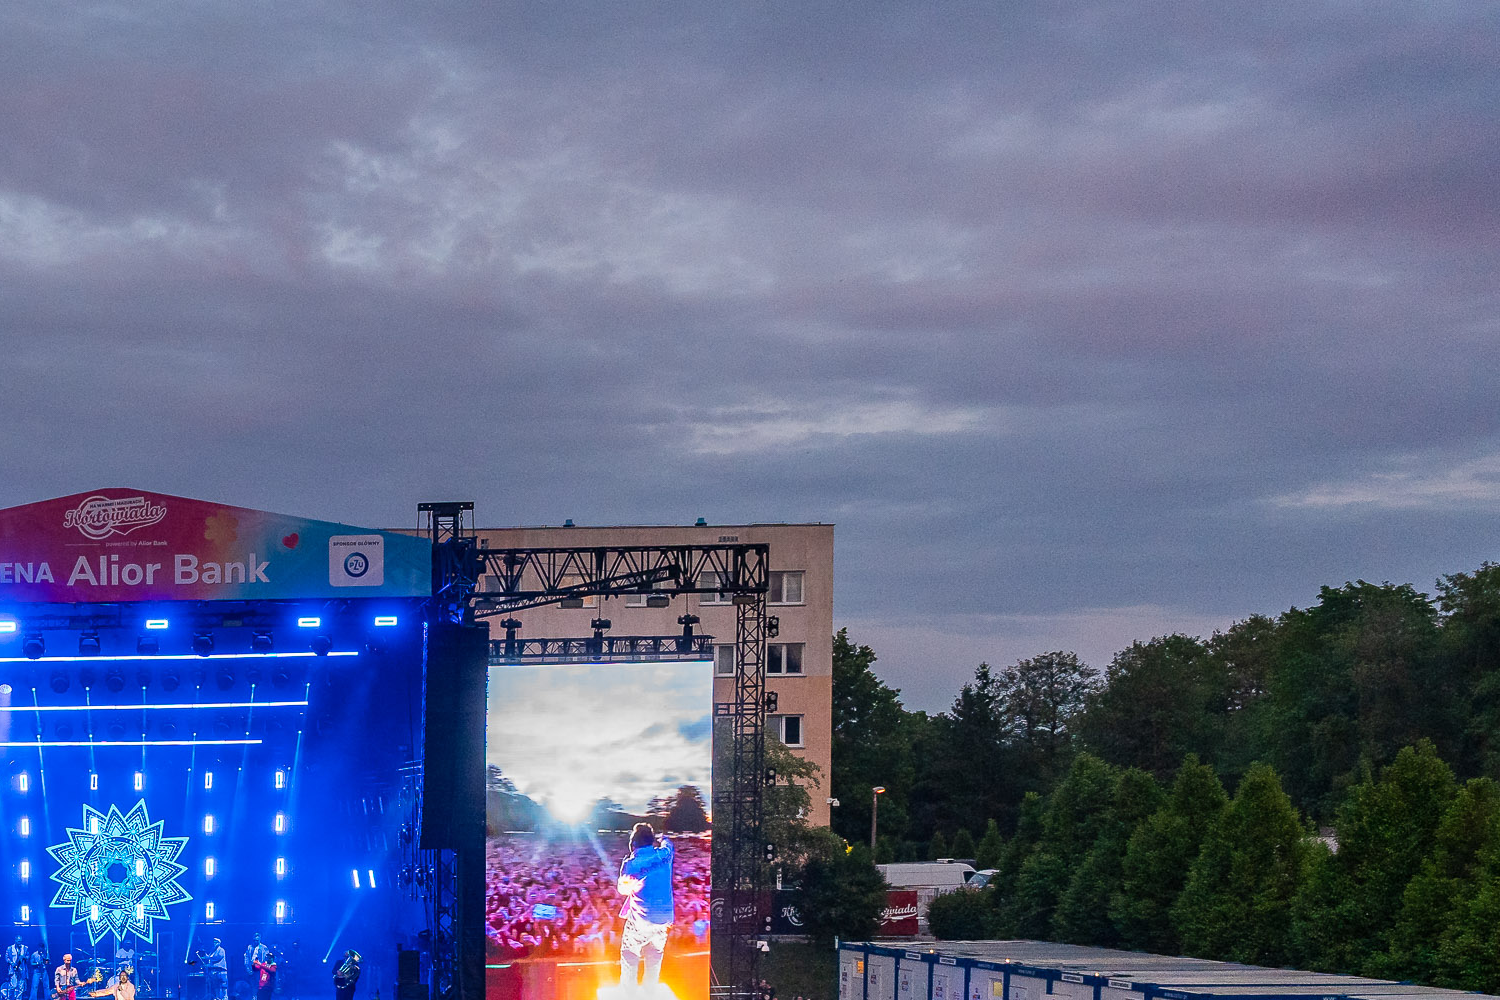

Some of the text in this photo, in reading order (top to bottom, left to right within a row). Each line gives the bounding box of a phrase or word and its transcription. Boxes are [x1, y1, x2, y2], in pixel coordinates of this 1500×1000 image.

[63, 501, 164, 528] Kortowiada
[66, 554, 162, 586] Alior
[174, 553, 271, 585] Bank
[349, 559, 364, 570] PZU
